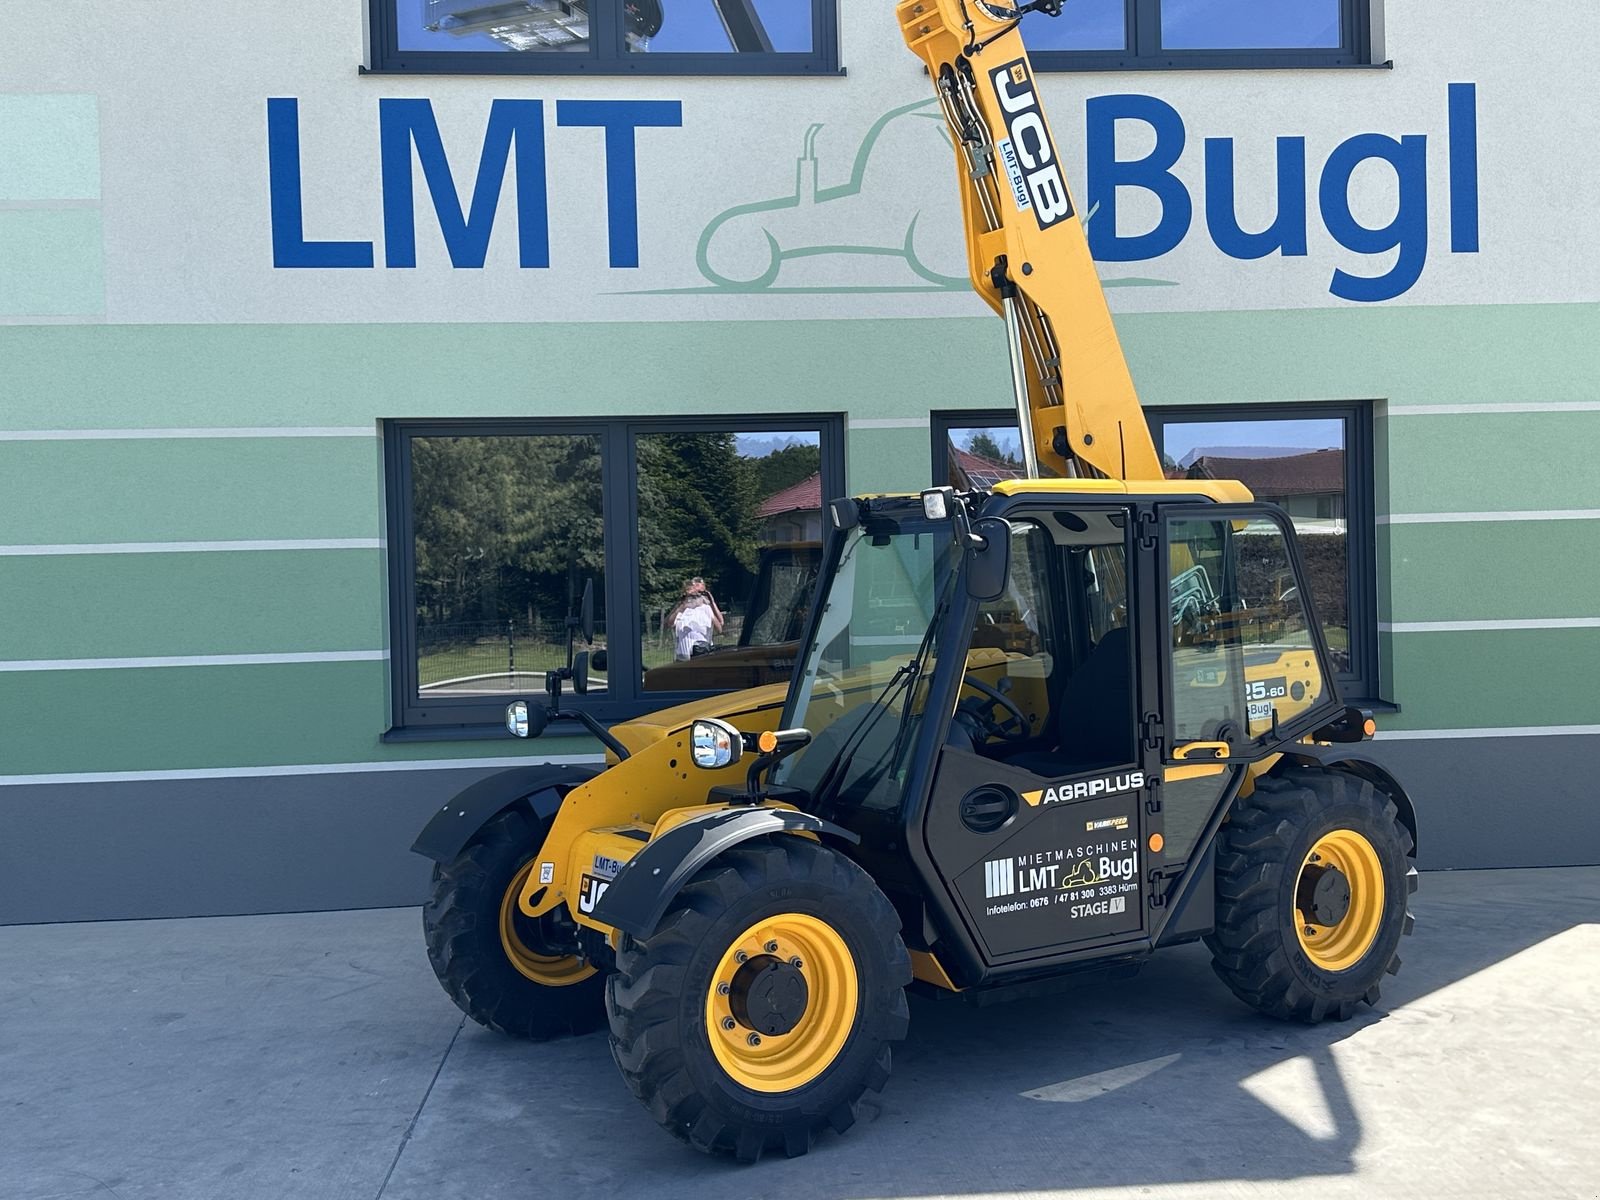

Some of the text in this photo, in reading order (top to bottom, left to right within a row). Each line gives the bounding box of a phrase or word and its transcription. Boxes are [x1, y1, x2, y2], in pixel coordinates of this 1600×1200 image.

[995, 69, 1068, 224] JCB
[267, 82, 1479, 302] LMT Bugl
[1002, 141, 1030, 206] LMT-Bugl
[1043, 772, 1145, 805] AGRIPLUS
[1018, 838, 1137, 867] MIETMASCHINEN
[1018, 850, 1138, 893] LMT Bugl
[986, 902, 1029, 916] Infotelefon:
[1029, 896, 1049, 908] 0676
[1081, 888, 1095, 900] 300
[1099, 885, 1118, 897] 3383
[1118, 882, 1138, 894] Hürm
[1070, 901, 1109, 919] STAGE
